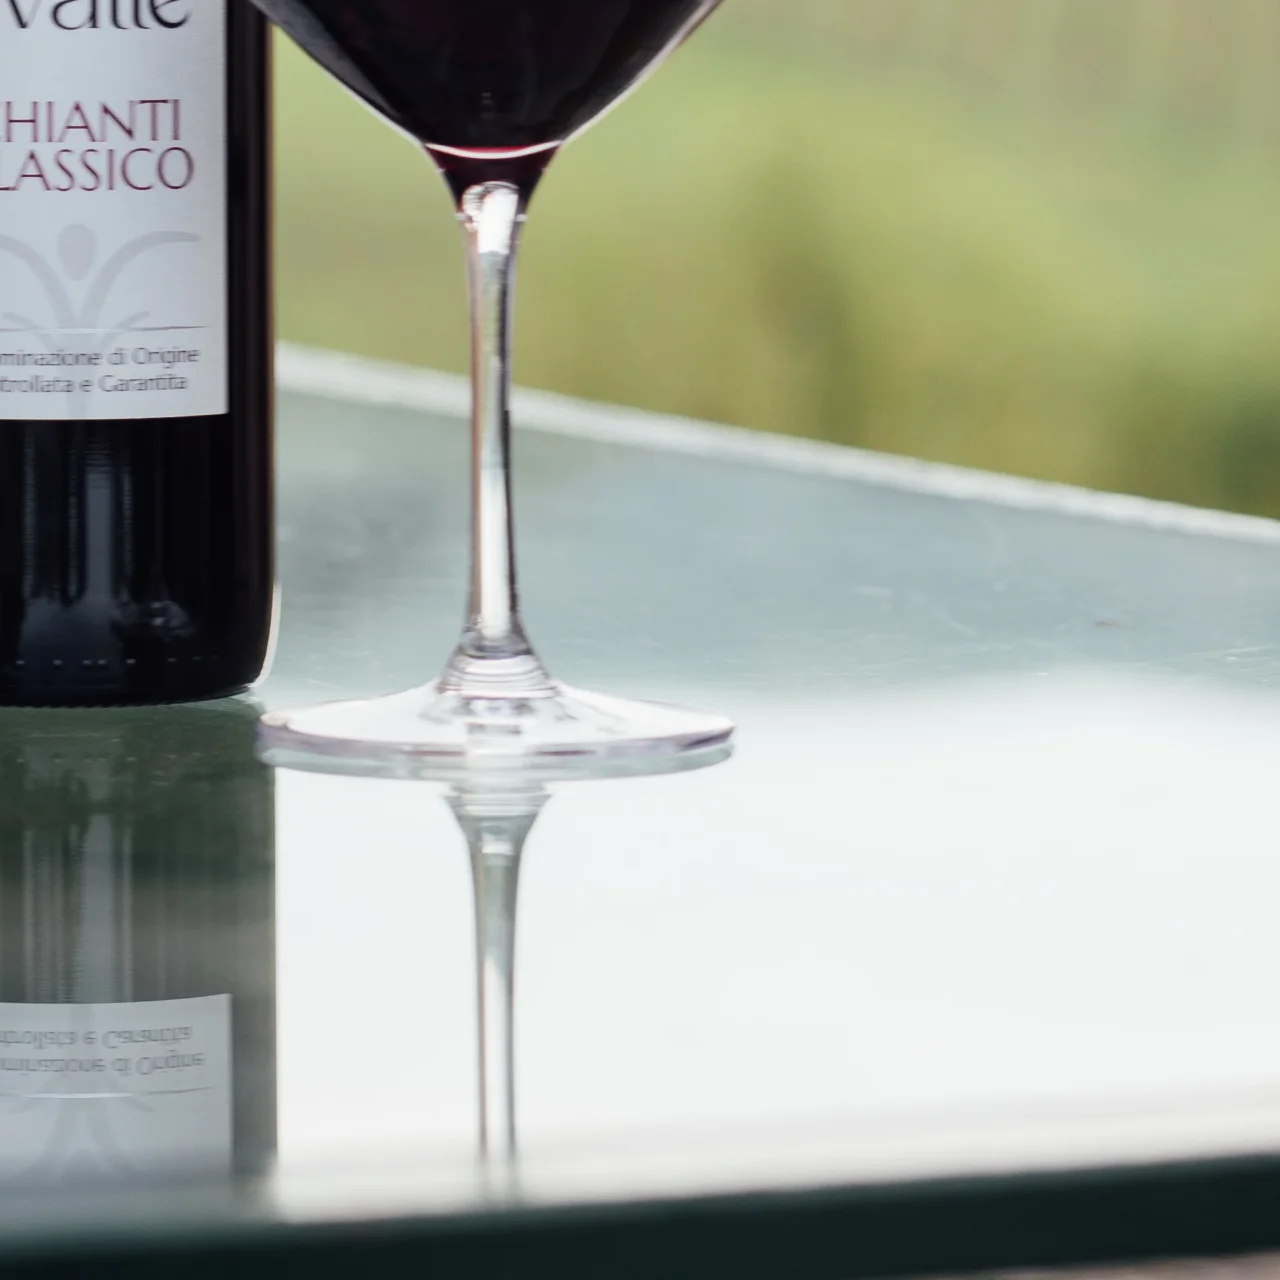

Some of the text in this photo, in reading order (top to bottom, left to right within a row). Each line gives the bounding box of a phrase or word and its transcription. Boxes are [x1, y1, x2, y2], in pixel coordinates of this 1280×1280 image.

[106, 348, 126, 366] di
[132, 346, 201, 369] Origine
[80, 378, 94, 392] e
[100, 373, 188, 393] Garantita
